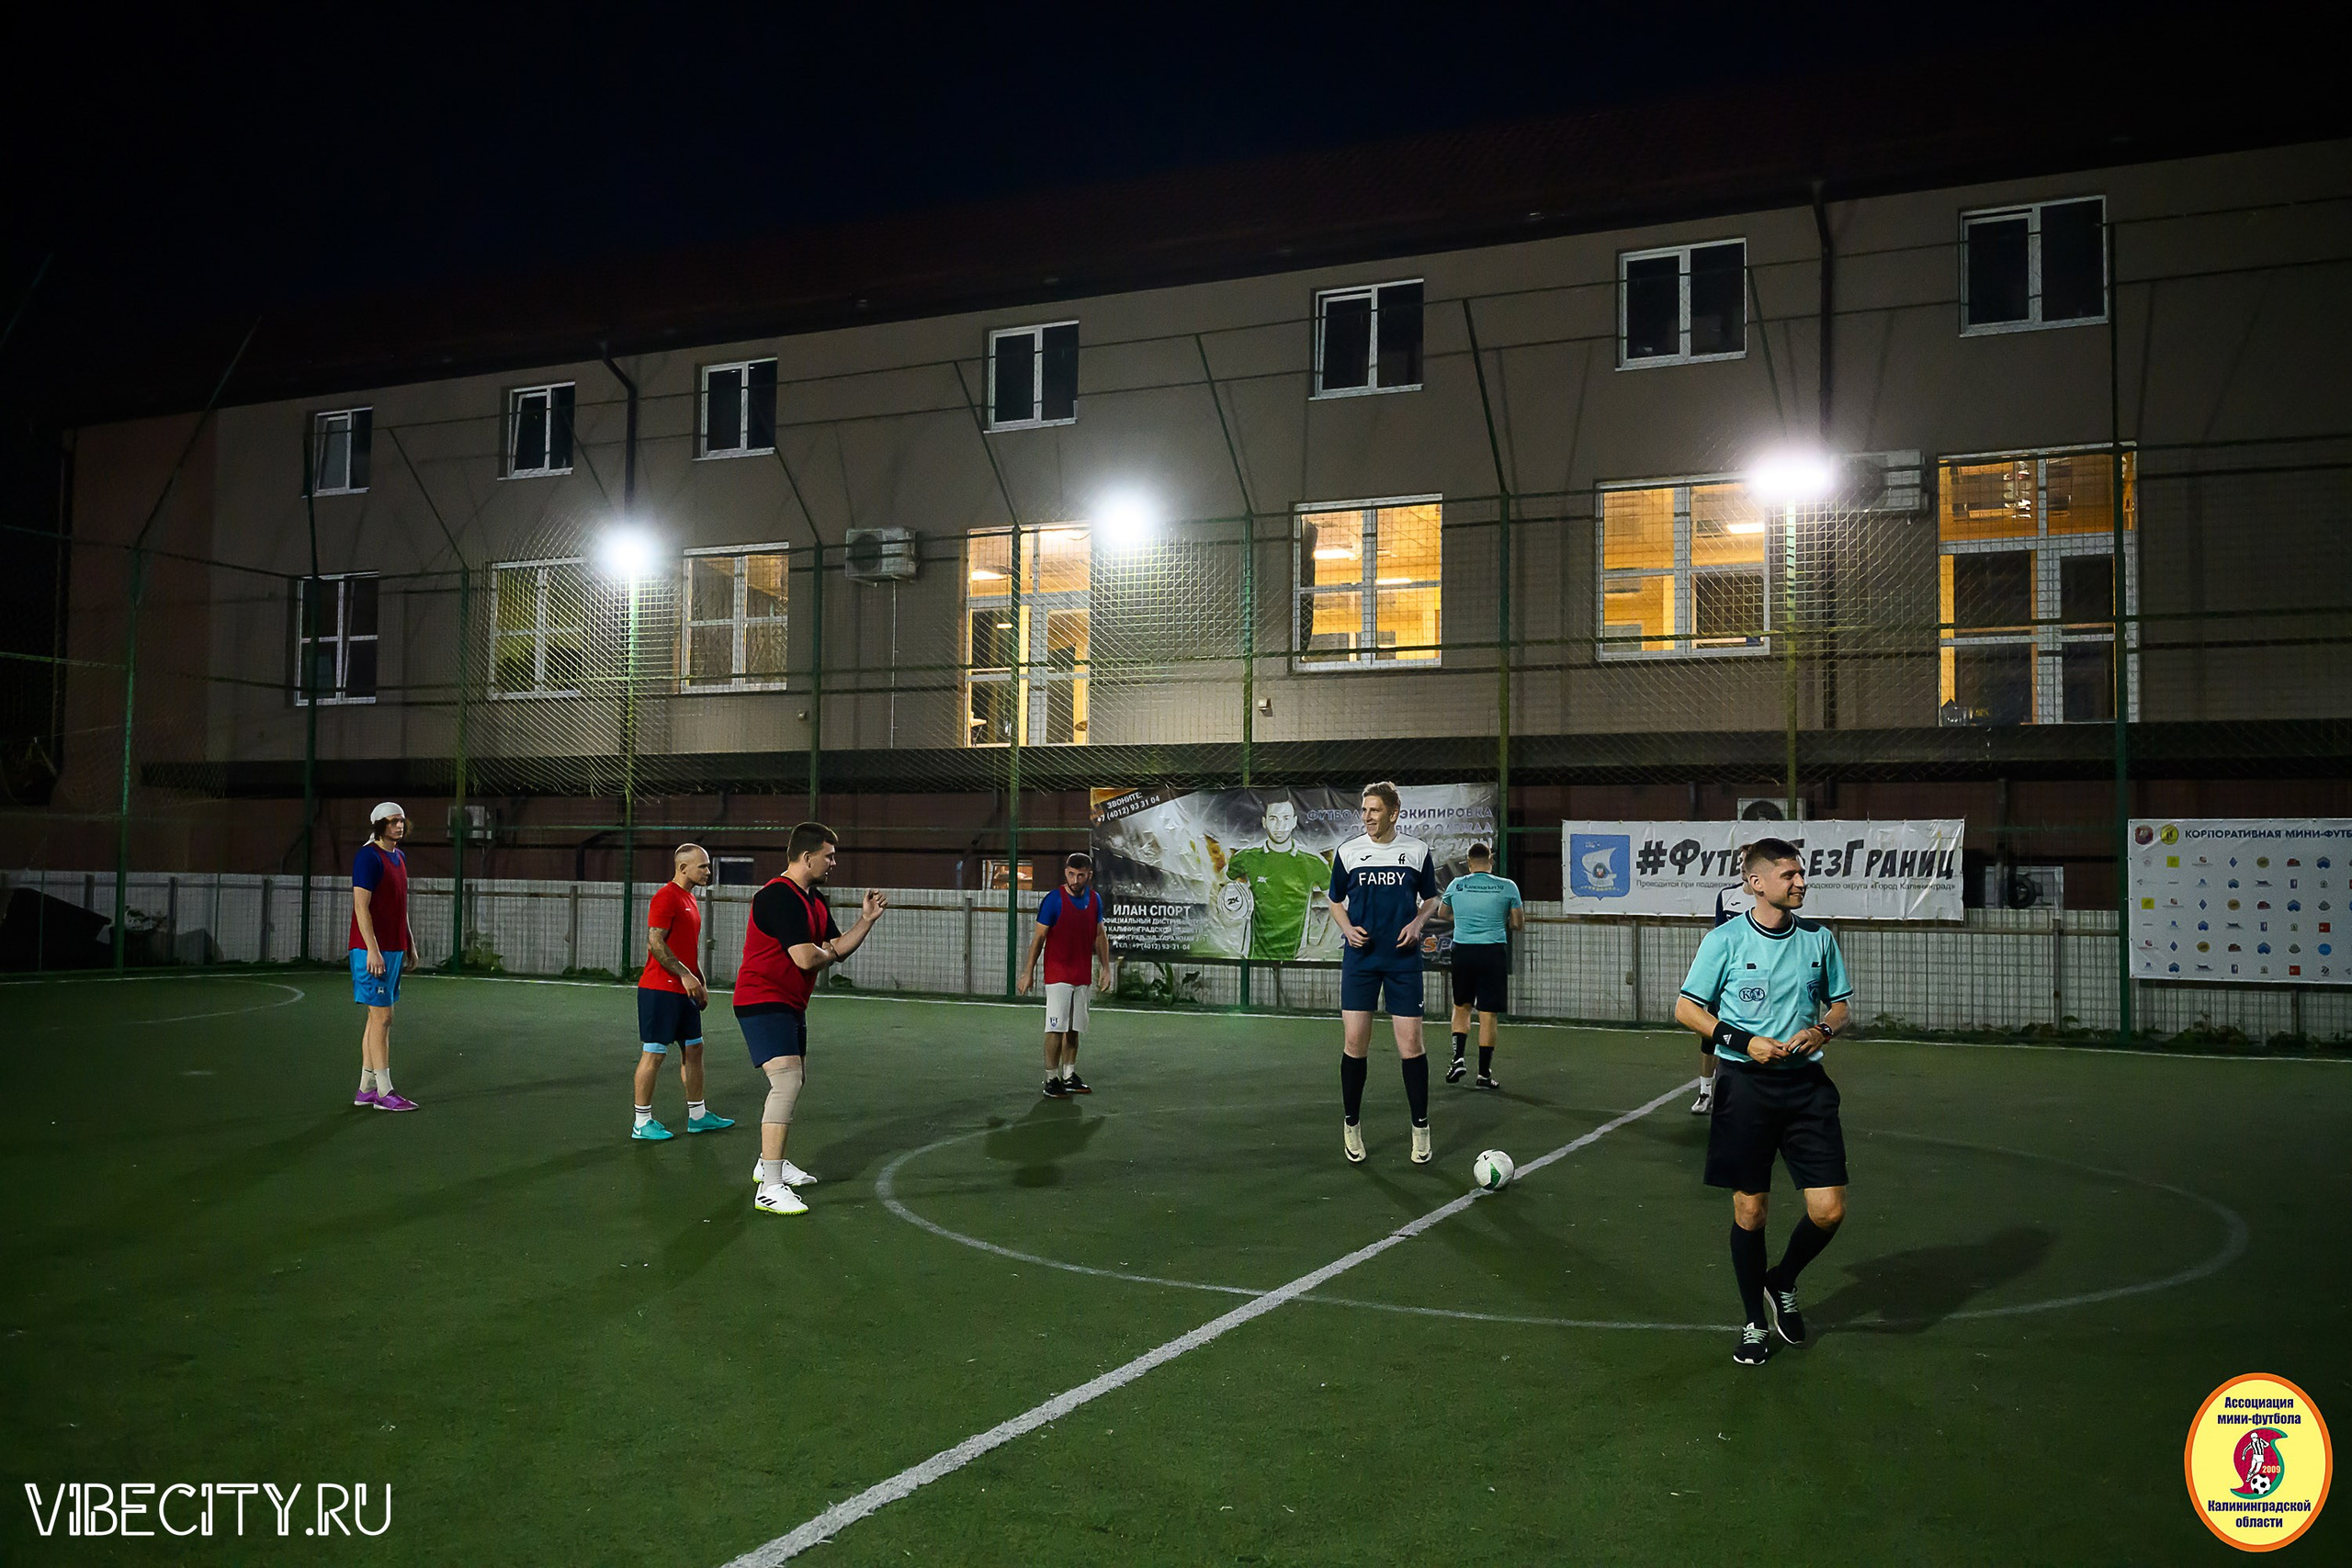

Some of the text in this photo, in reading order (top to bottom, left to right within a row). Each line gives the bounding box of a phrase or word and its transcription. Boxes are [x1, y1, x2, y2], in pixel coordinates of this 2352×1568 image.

[1106, 792, 1143, 809] ЗВОНИТЕ:
[1106, 806, 1129, 820] (4012)
[1131, 802, 1139, 811] 93
[1141, 799, 1149, 807] 31
[1150, 795, 1160, 804] 04
[1306, 807, 1493, 821] ФУТБОЛ ЭКИПИРОВКА
[2185, 829, 2281, 839] КОРПОРАТИВНАЯ
[1359, 872, 1406, 886] FARBY
[1636, 880, 1679, 888] Проводится
[1871, 882, 1898, 890] «Город
[1113, 904, 1192, 917] ИЛАН СПОРТ
